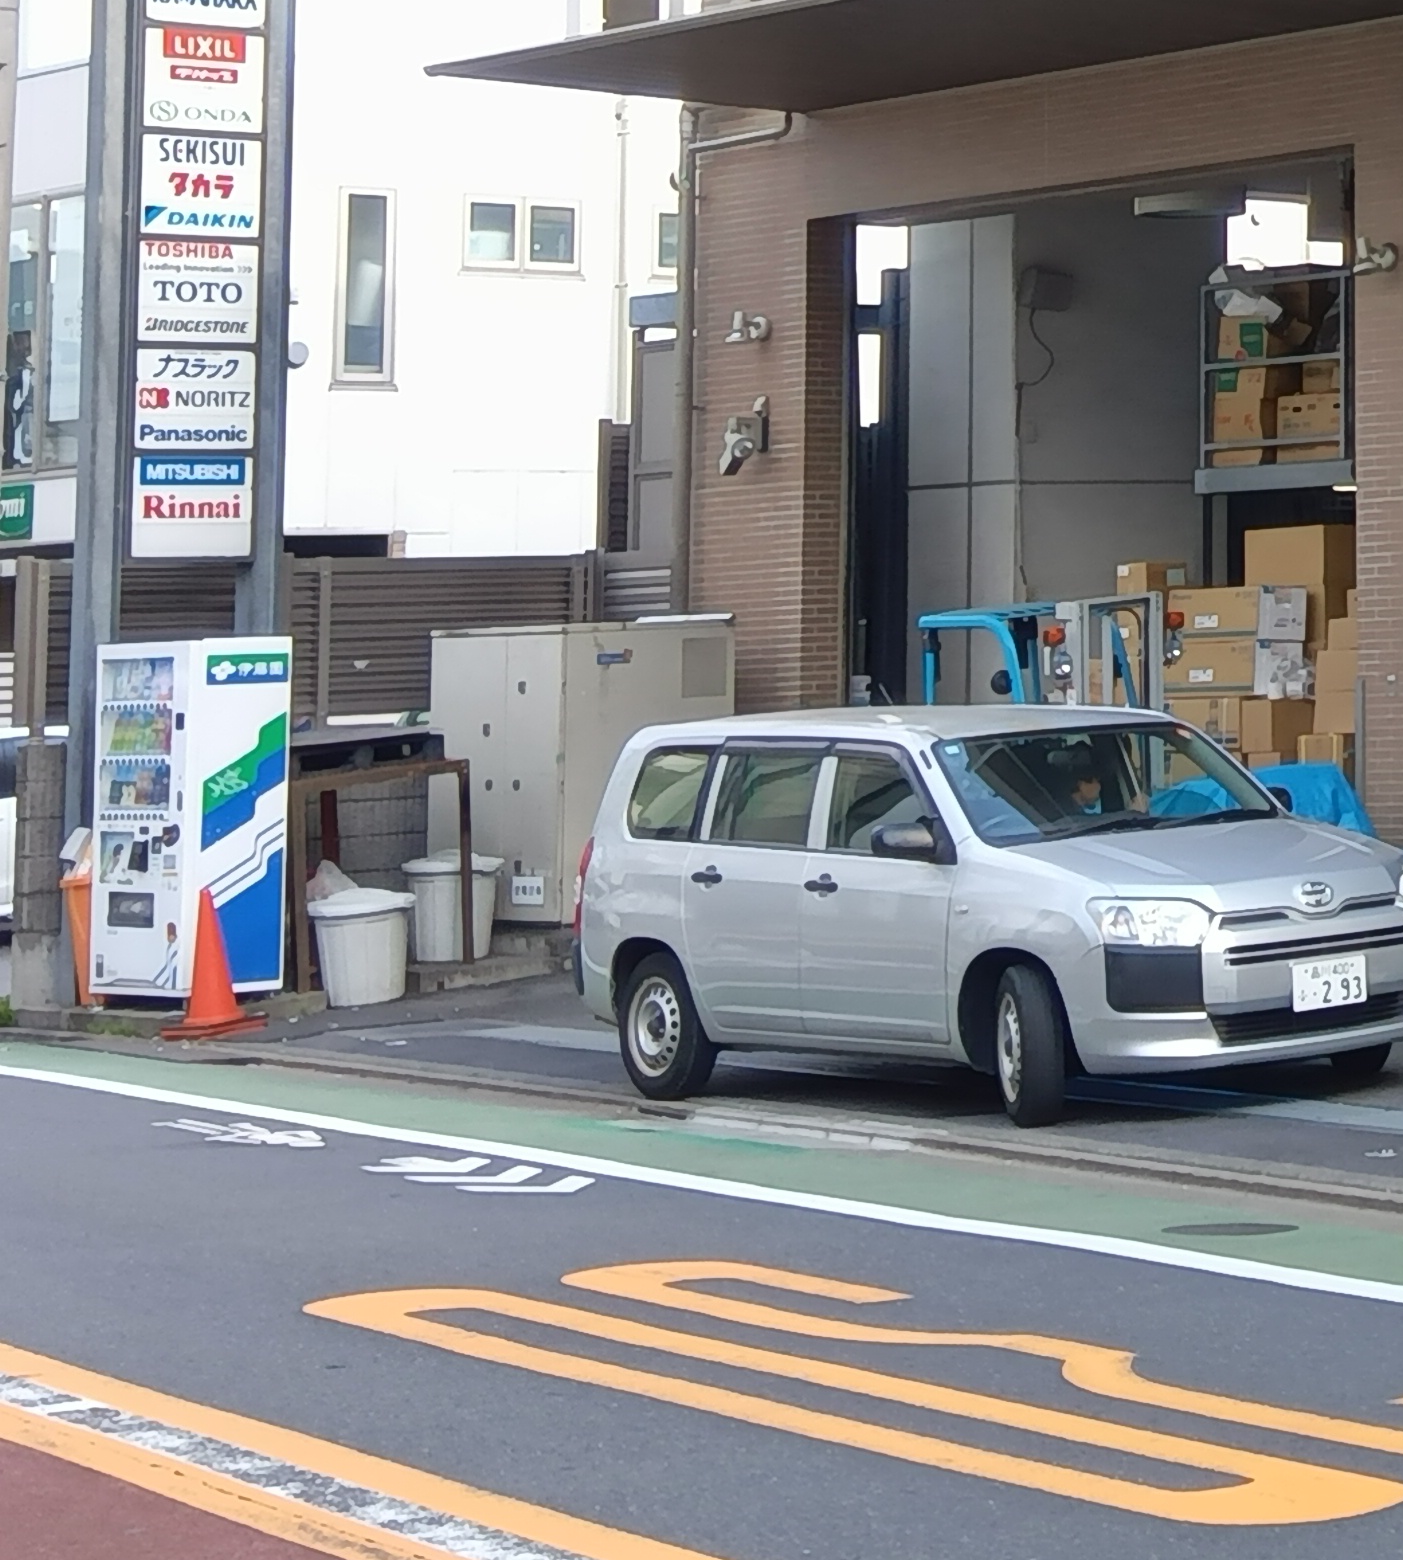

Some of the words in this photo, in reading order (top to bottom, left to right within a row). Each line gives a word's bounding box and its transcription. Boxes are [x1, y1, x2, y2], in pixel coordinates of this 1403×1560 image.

[174, 35, 236, 59] LIXIL
[184, 106, 252, 123] ONDA
[159, 137, 245, 166] SEKISUI
[168, 171, 234, 199] タカラ
[167, 211, 254, 229] DAIKIN
[144, 242, 234, 260] TOSHIBA
[153, 280, 243, 304] TOTO
[144, 317, 249, 334] BRIDGESTONE
[152, 353, 240, 379] ナスラック
[175, 390, 251, 408] NORITZ
[139, 423, 248, 443] Panasonic
[146, 463, 240, 481] MITSUBISHI
[142, 493, 241, 519] Rinnai
